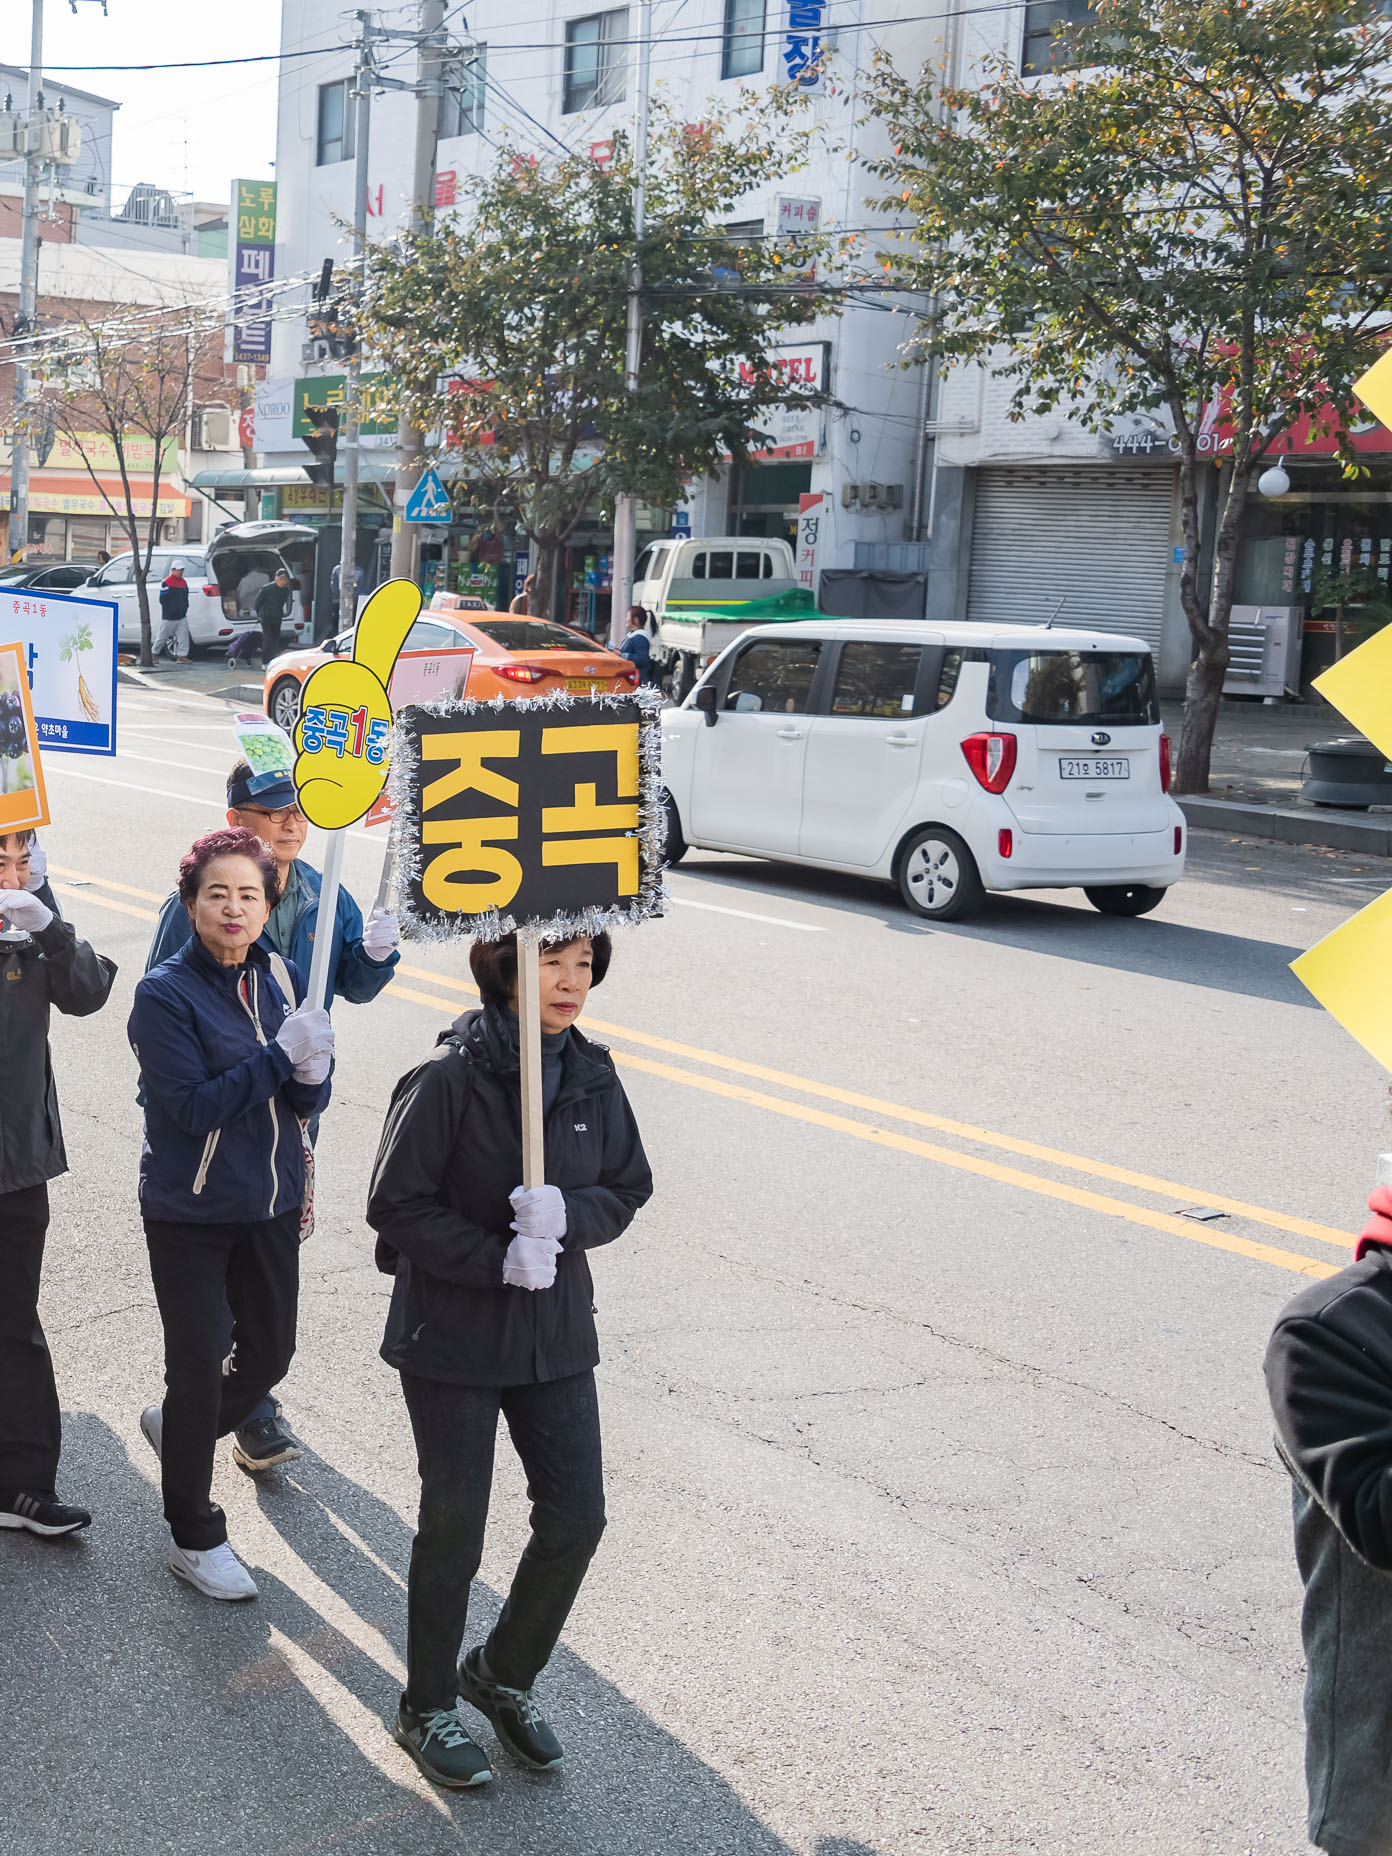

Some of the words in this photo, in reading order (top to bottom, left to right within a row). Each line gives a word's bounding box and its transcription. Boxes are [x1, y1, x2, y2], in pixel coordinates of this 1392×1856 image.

[239, 186, 275, 211] 노루
[238, 215, 275, 240] 삼화
[257, 402, 290, 417] NOROO
[1112, 433, 1220, 454] 444-001
[800, 516, 820, 545] 정
[12, 600, 48, 618] 중곡1동
[459, 600, 483, 609] TAXI
[41, 722, 69, 739] 약초마을
[300, 705, 392, 766] 중곡1동
[1067, 761, 1090, 776] 21오
[1095, 761, 1124, 776] 5817
[420, 720, 641, 916] 중곡
[573, 1123, 588, 1132] K2
